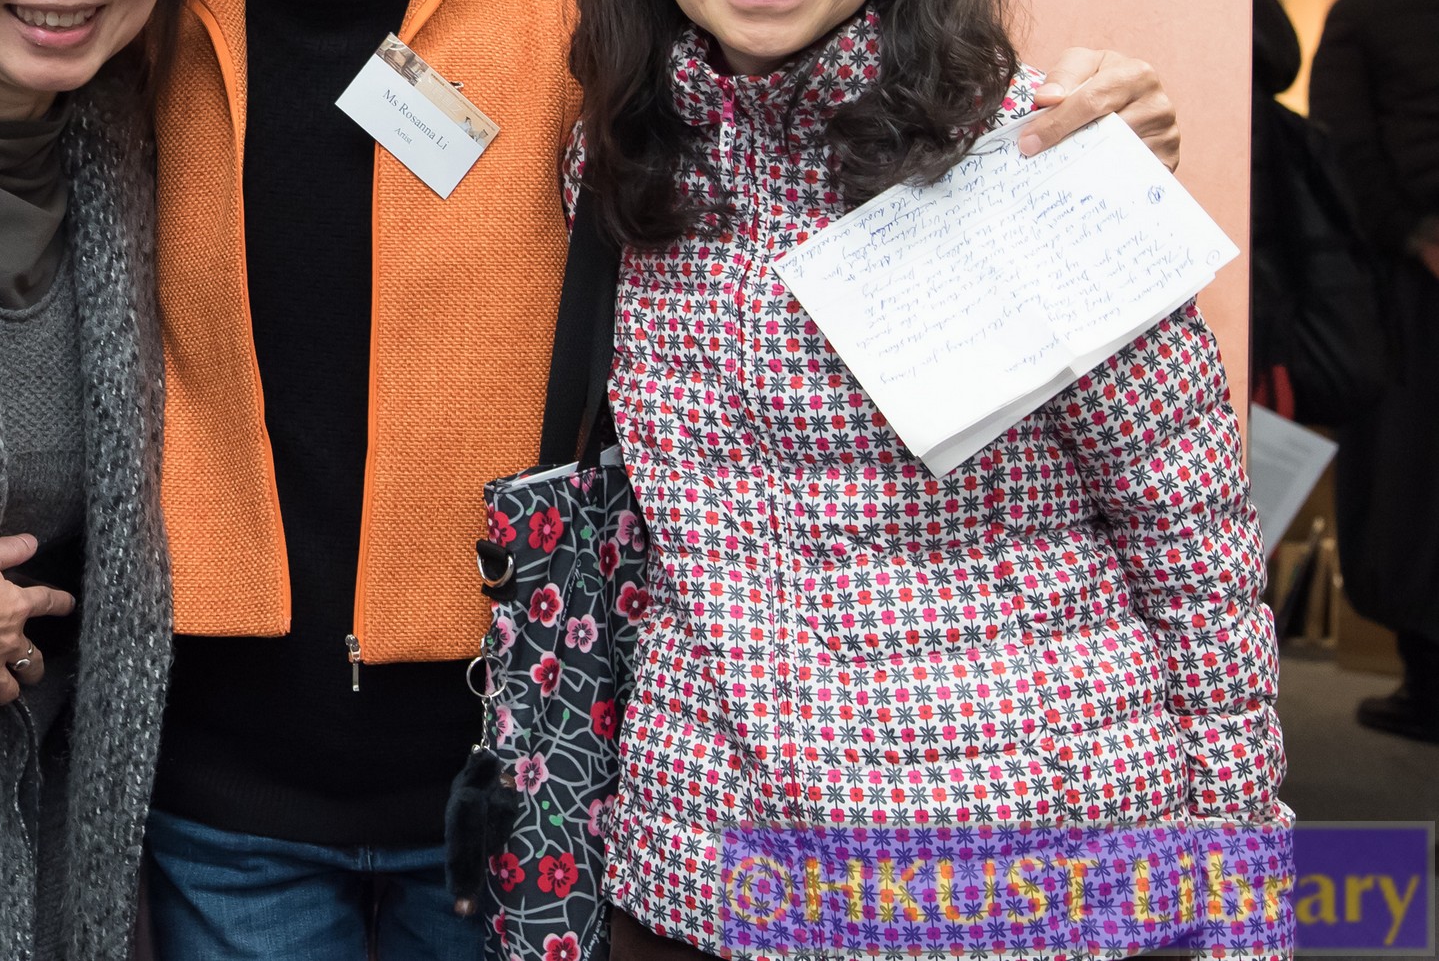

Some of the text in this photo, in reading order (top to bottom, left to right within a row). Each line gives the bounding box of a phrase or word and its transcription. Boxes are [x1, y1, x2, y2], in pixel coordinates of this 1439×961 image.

[382, 89, 450, 151] Ms Rosanna Li
[394, 127, 414, 145] Artist
